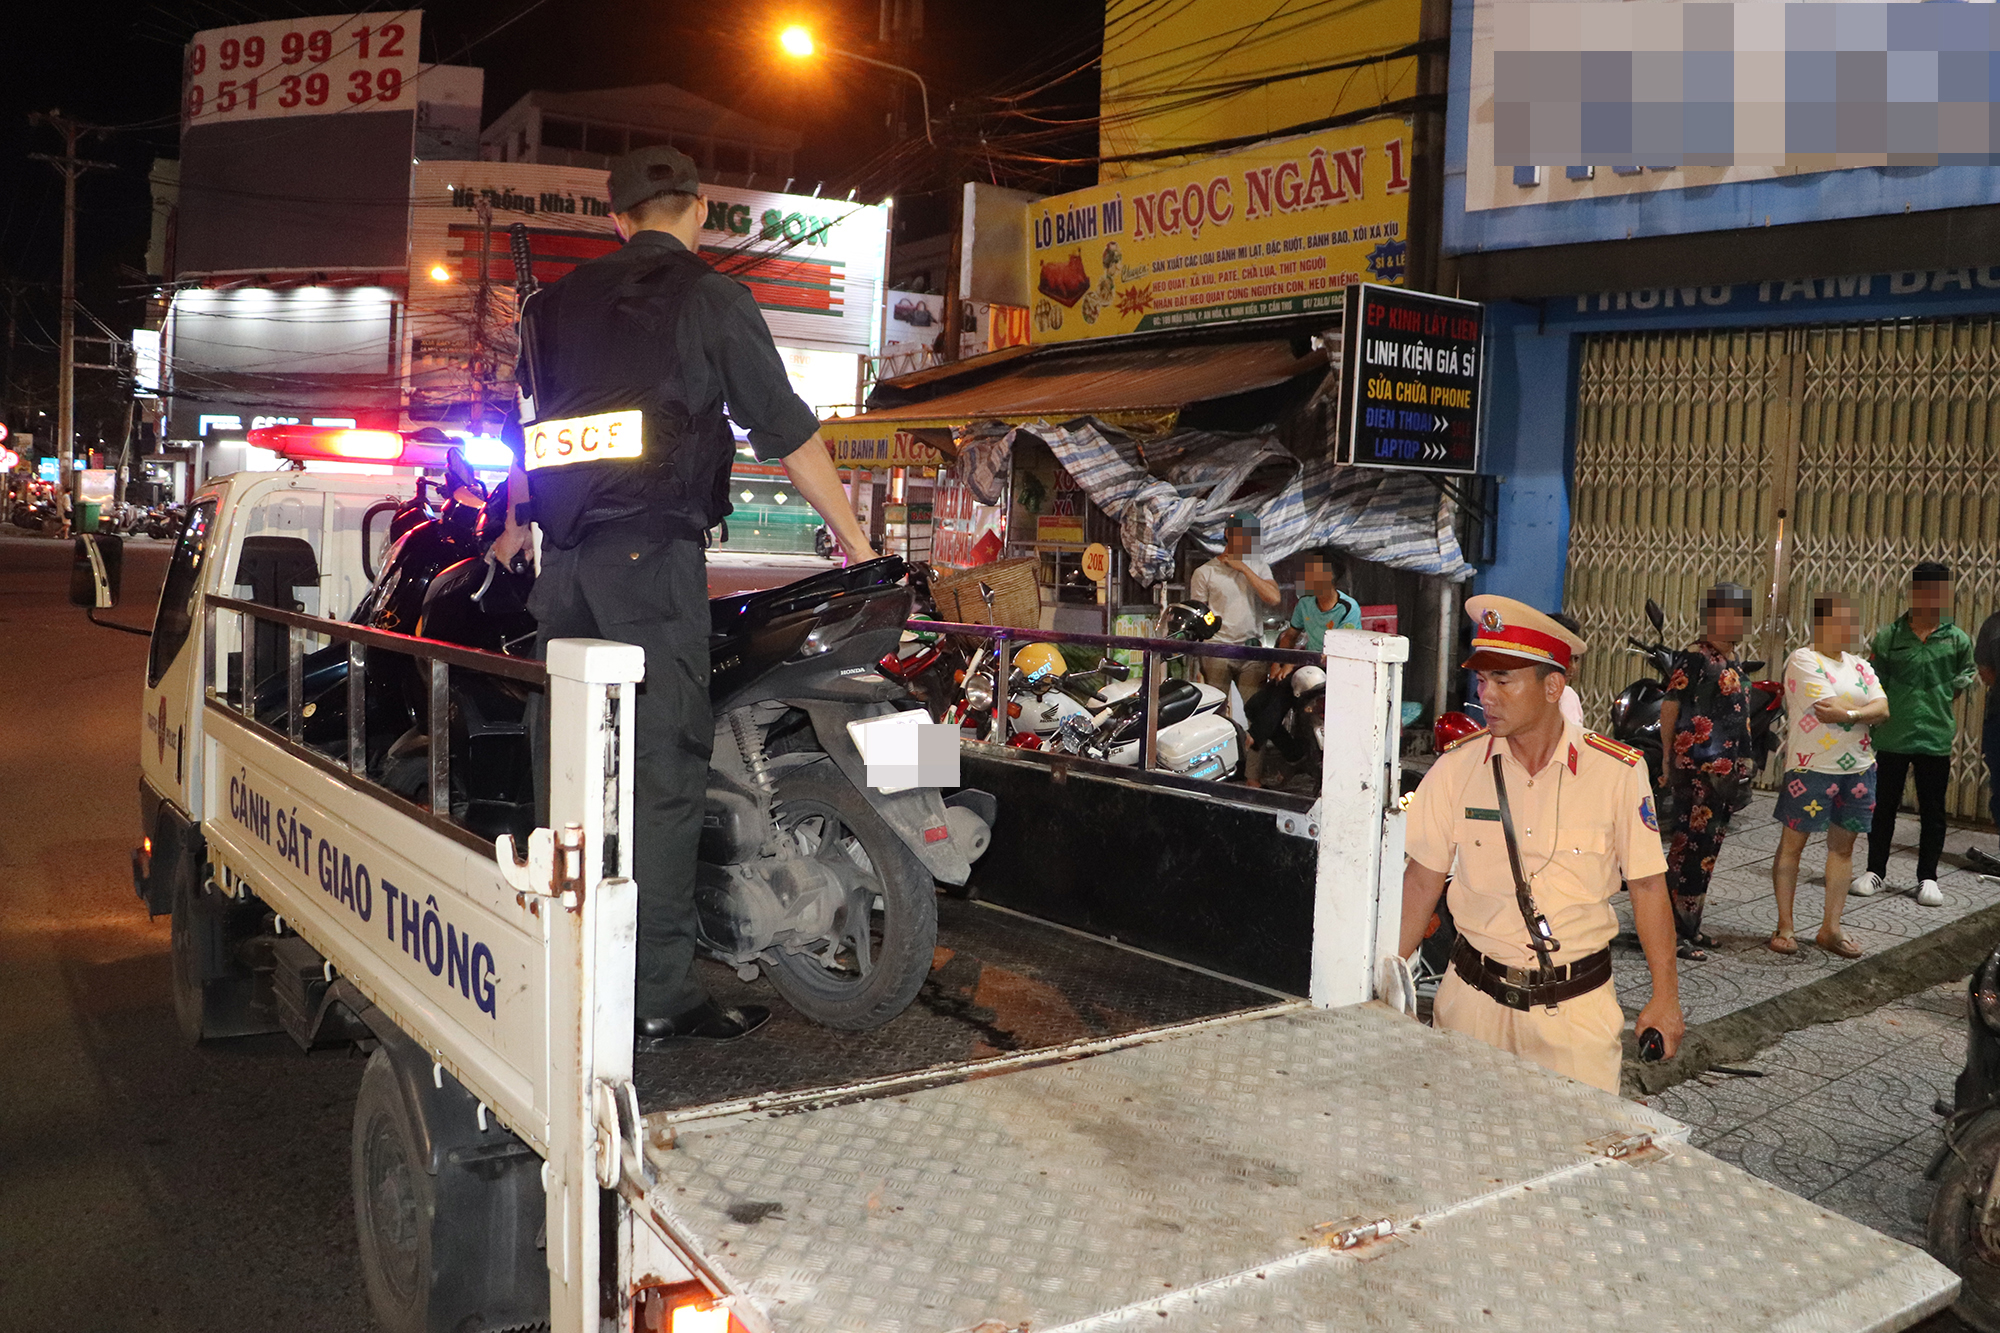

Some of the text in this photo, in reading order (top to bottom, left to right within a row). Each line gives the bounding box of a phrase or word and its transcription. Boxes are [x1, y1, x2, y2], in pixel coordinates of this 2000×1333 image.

[219, 36, 265, 71] 99
[281, 30, 332, 65] 99
[351, 24, 405, 59] 12
[216, 78, 258, 113] 51
[278, 72, 329, 108] 39
[347, 67, 402, 104] 39
[540, 192, 575, 214] Nhà
[1035, 137, 1410, 250] LÒ BÁNH MÌ NGỌC NGÂN 1
[1217, 247, 1236, 263] BÁNH
[1307, 231, 1329, 248] BÁNH
[1332, 229, 1351, 245] BAO,
[1353, 223, 1367, 241] XÔI
[1370, 222, 1382, 239] XÁ
[1383, 219, 1399, 237] XÍU
[1153, 281, 1166, 293] HEO
[1279, 260, 1297, 276] THỊT
[1300, 256, 1326, 273] NGUỘI
[1190, 293, 1204, 306] HEO
[1206, 291, 1225, 304] QUAY
[1286, 281, 1307, 294] CON,
[1309, 277, 1325, 290] HEO
[1366, 338, 1475, 378] LINH KIỆN GIÁ SỈ
[1367, 372, 1471, 409] SỬA CHỮA IPHONE
[838, 434, 848, 460] LÒ
[877, 435, 888, 460] MÌ
[1375, 437, 1420, 460] LAPTOP
[1087, 552, 1104, 572] 20K
[840, 667, 865, 676] HONDA
[1028, 662, 1053, 683] CSGT
[229, 766, 497, 1021] CẢNH SÁT GIAO THÔNG
